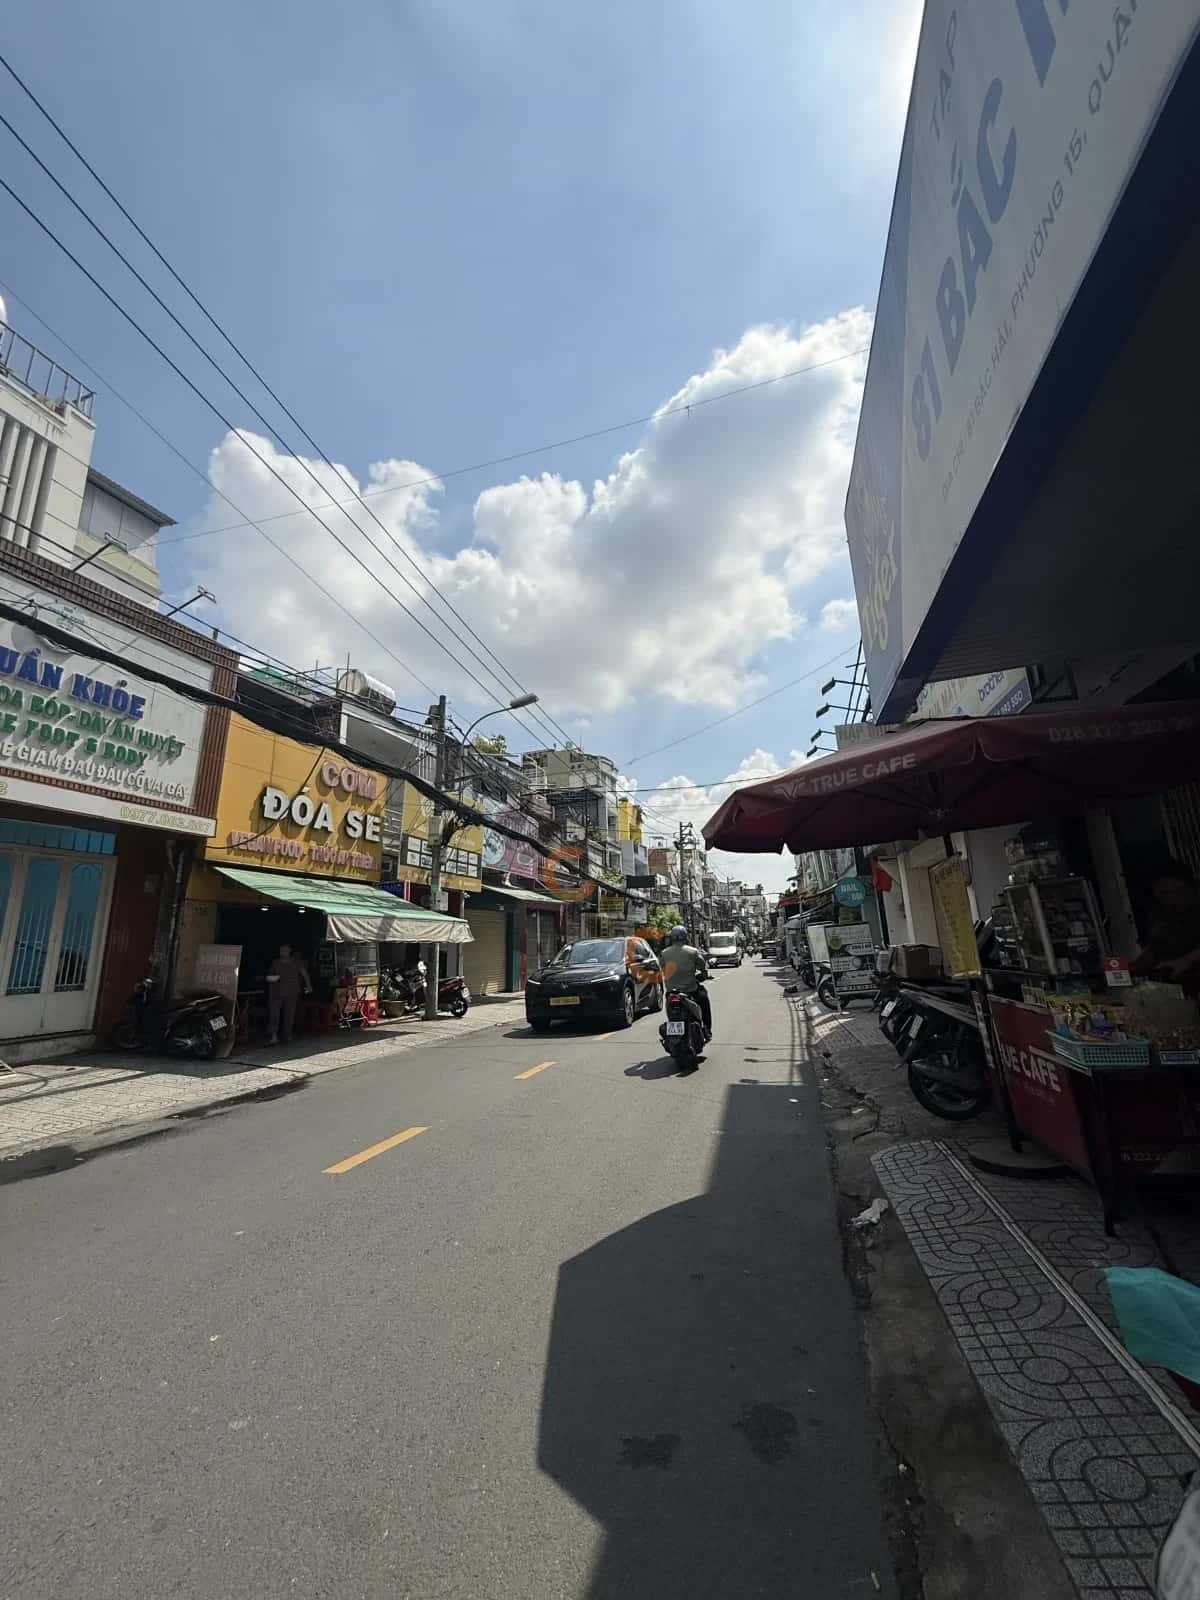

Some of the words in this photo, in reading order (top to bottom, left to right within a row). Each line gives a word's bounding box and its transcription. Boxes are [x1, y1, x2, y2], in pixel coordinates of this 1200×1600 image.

[1088, 0, 1138, 116] QUẬ
[911, 331, 943, 463] 81
[936, 76, 1018, 378] BẮC
[0, 684, 23, 706] OA
[103, 740, 149, 769] BODY
[810, 768, 857, 793] TRUE
[862, 753, 918, 778] CAFE
[263, 785, 334, 832] ĐÓA
[1020, 1051, 1061, 1092] CAFE
